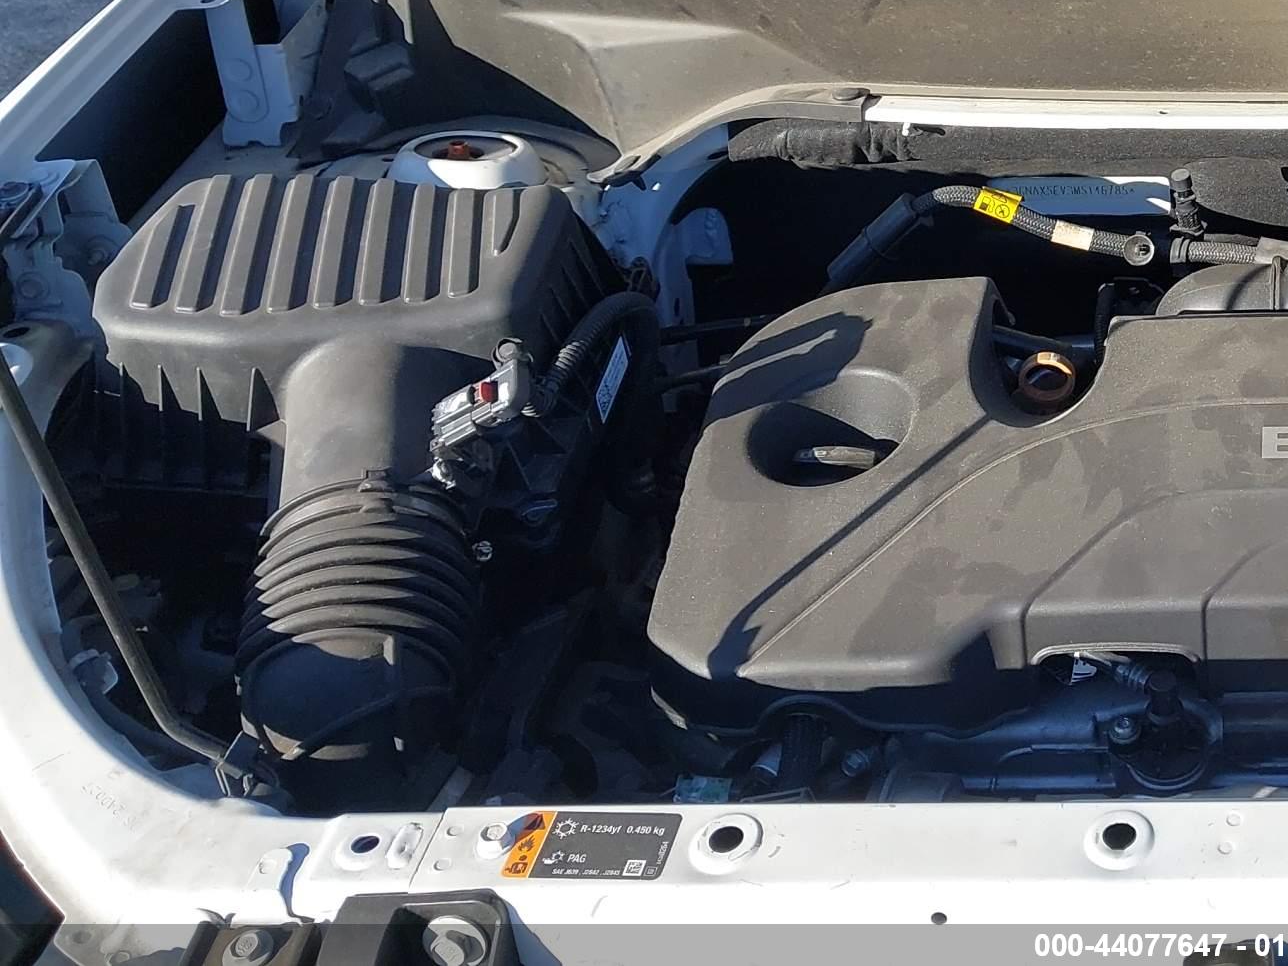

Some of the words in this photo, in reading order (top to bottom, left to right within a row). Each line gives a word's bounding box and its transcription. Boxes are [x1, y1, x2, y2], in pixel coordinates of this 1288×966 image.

[580, 824, 622, 835] R-1234yf
[626, 825, 651, 834] 0.450
[652, 825, 665, 836] kg
[567, 853, 587, 863] PAG
